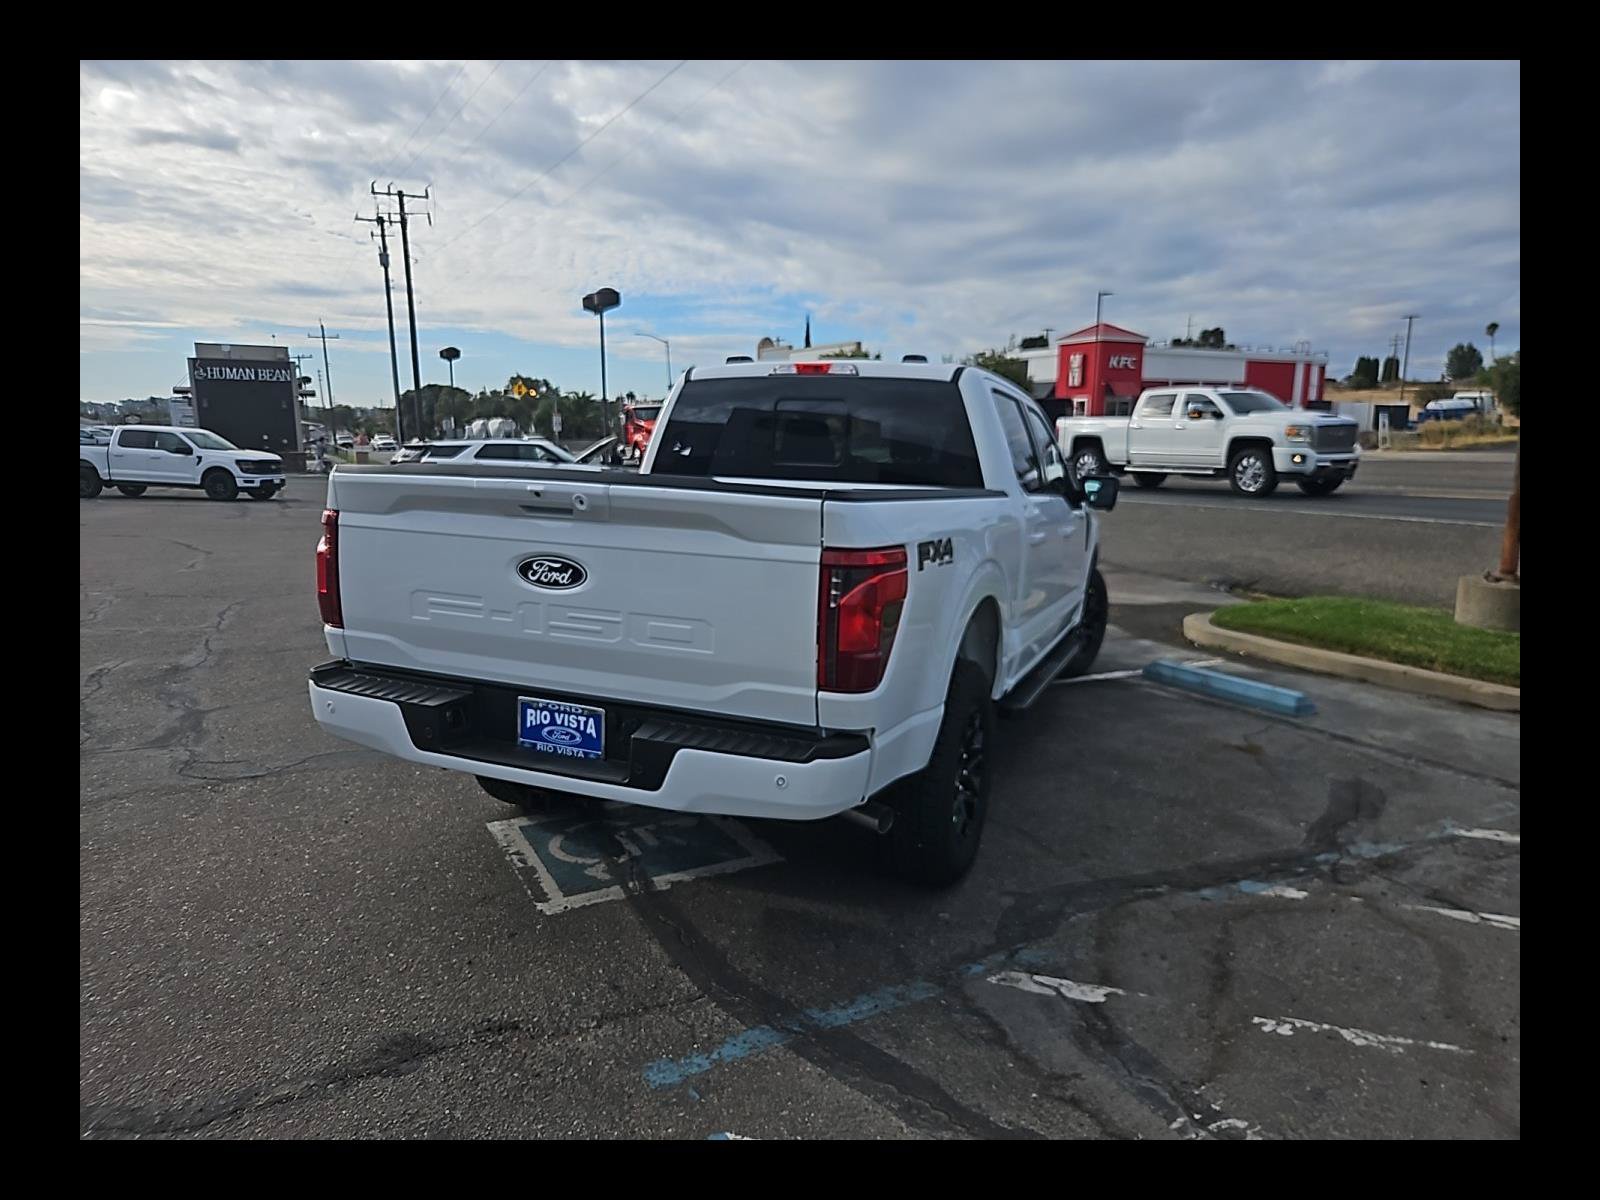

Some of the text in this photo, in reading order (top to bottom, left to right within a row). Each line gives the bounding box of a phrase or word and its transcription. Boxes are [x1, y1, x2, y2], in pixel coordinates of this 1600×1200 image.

[1109, 355, 1137, 370] KFC
[206, 366, 291, 382] HUMAN BEAN
[917, 537, 953, 572] FX4
[528, 560, 573, 584] Ford
[410, 588, 715, 656] F-150
[538, 702, 583, 714] FORD
[526, 708, 597, 739] RIO VISTA
[536, 743, 585, 759] RIO VISTA
